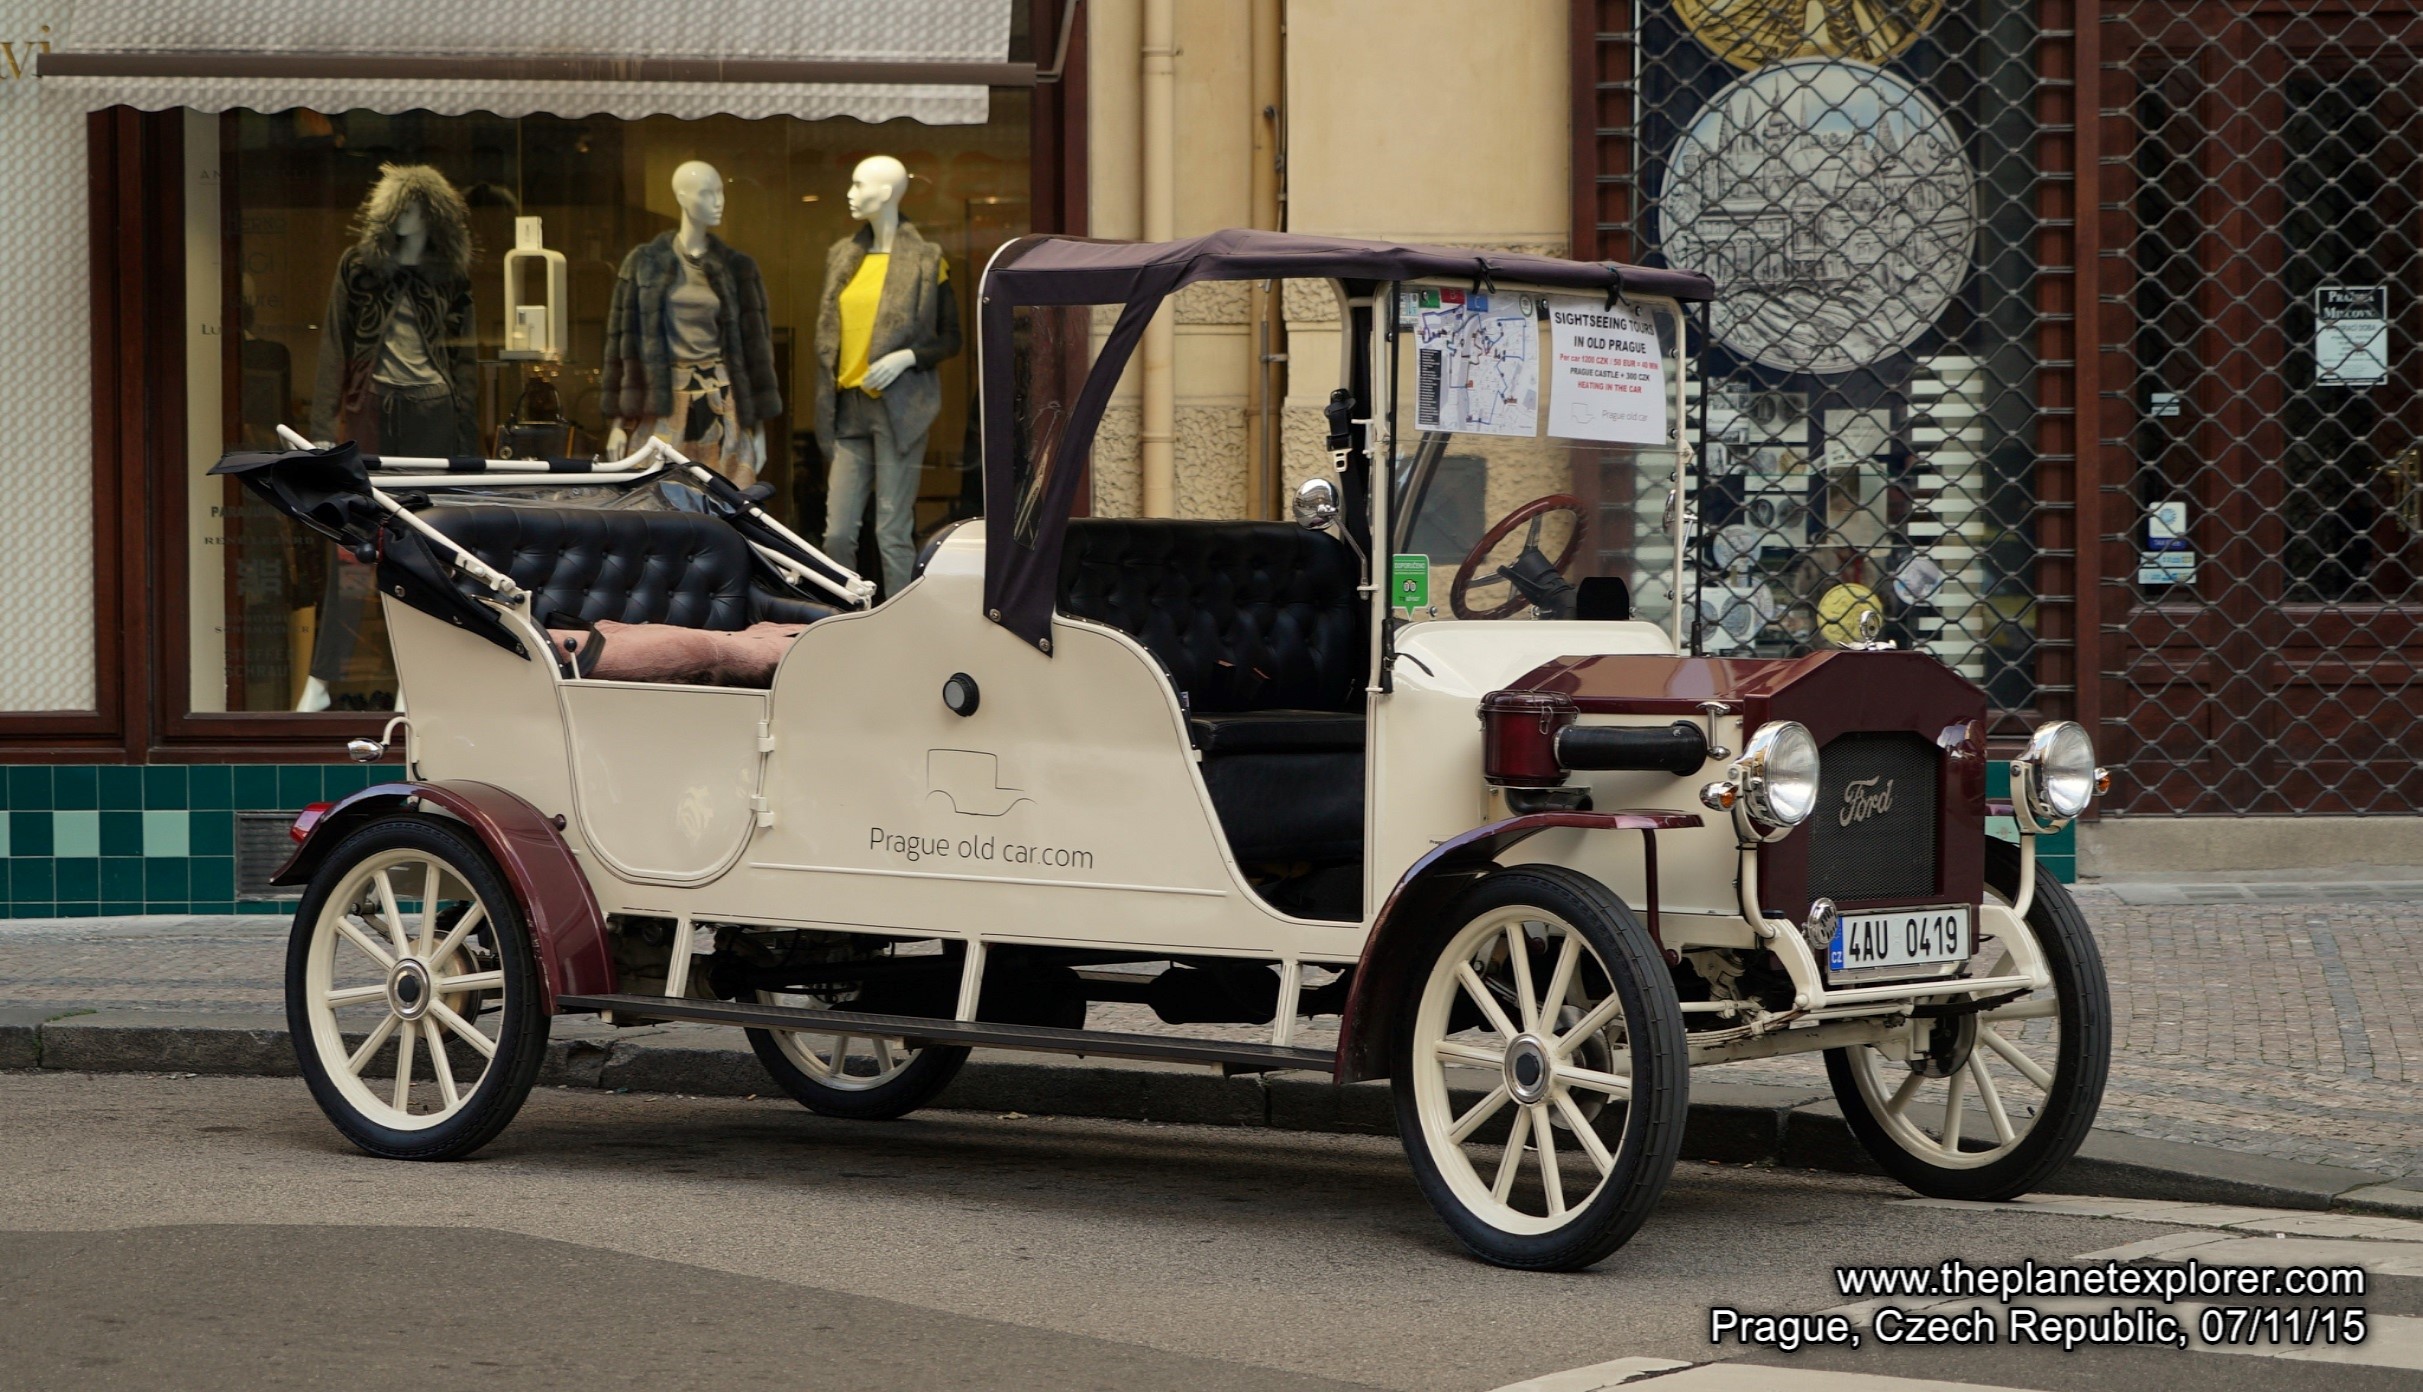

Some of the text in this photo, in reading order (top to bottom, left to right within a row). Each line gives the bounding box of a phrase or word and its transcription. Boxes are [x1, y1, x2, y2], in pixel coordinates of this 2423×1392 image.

[1554, 311, 1655, 336] SIGHTSEEING TOURS
[1574, 335, 1646, 354] IN OLD PRAGUE
[1560, 353, 1570, 361] Per
[1596, 356, 1608, 365] CZK
[1623, 359, 1636, 368] EUR
[1570, 367, 1593, 377] PRAGUE
[1594, 369, 1619, 379] CASTLE
[1626, 372, 1637, 381] 300
[1638, 373, 1650, 382] CZK
[1577, 381, 1642, 394] HEATING IN THE CAR
[1601, 409, 1625, 422] Prague
[1839, 775, 1894, 828] Ford
[870, 827, 1094, 869] Prague old car.com
[1848, 915, 1958, 963] 4AU 0419
[1831, 950, 1843, 964] CZ
